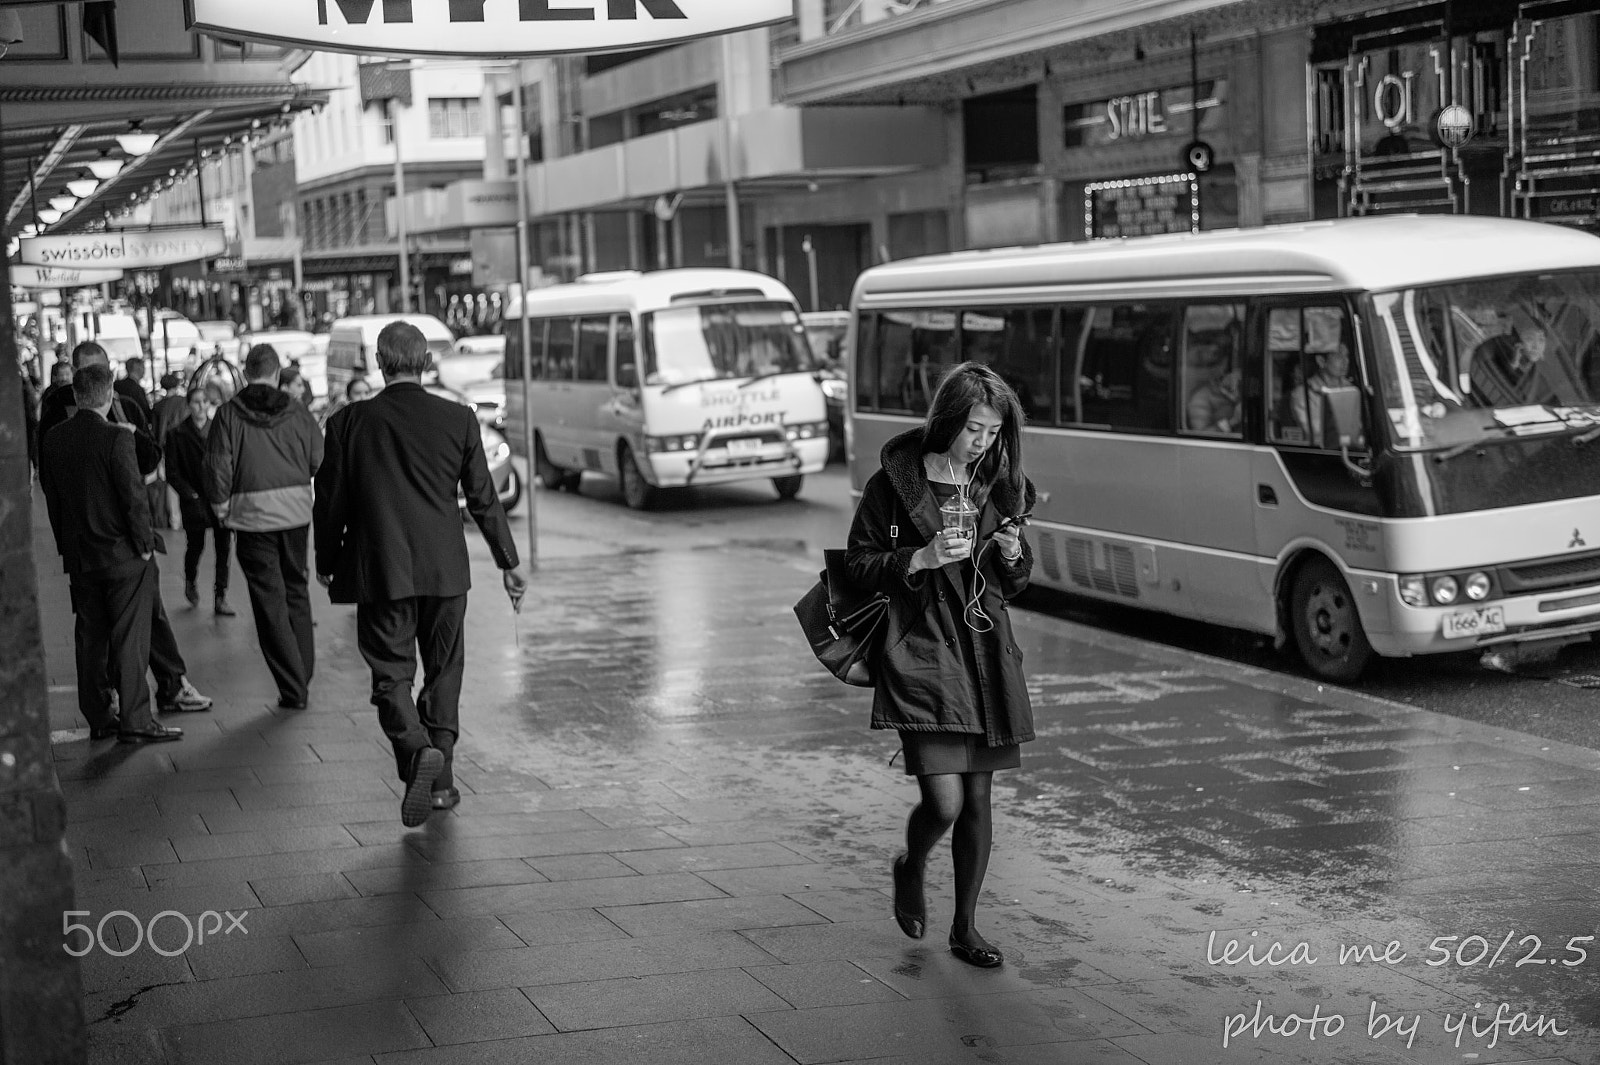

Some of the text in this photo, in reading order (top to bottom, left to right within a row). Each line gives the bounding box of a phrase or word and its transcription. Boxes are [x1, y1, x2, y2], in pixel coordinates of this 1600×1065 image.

[41, 237, 206, 263] swissôtel SYDNEY
[700, 389, 781, 408] SHUTTLE
[702, 410, 788, 430] AIRPORT
